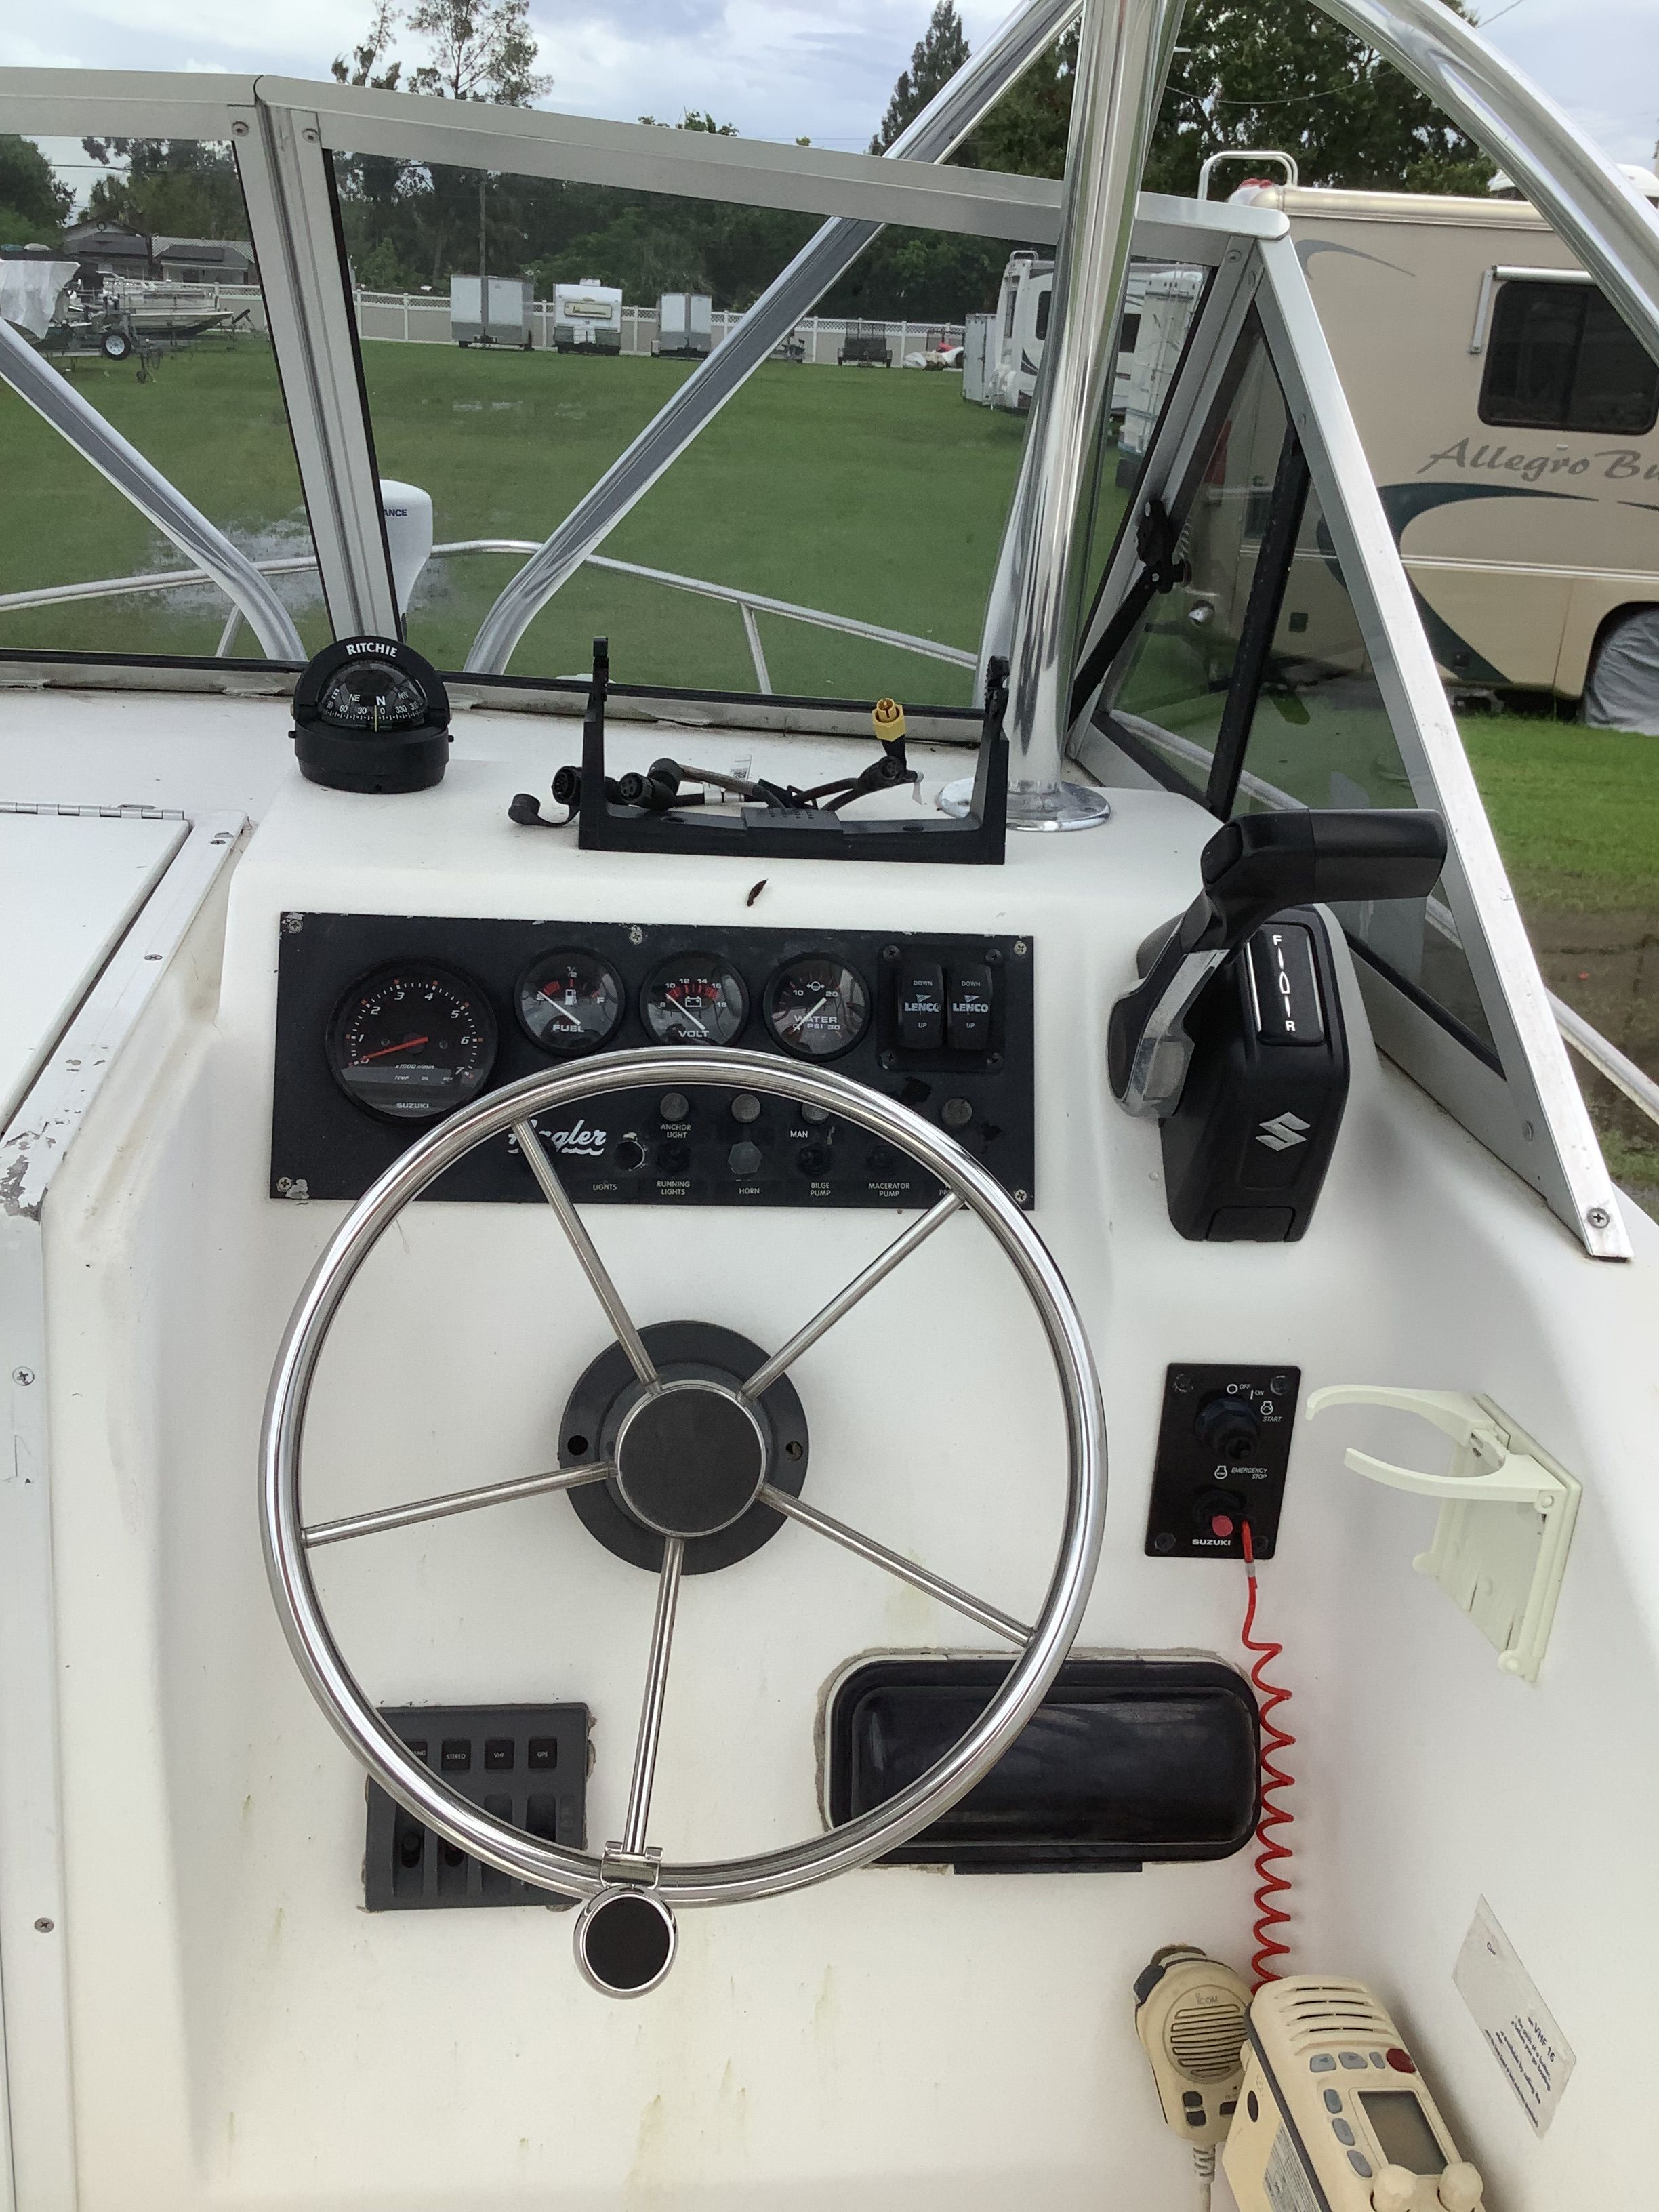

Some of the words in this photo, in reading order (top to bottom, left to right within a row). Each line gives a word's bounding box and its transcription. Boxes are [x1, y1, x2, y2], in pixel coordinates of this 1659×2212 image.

[1416, 438, 1590, 482] Allegro
[346, 642, 398, 657] RITCHIE
[331, 688, 340, 699] E
[349, 694, 361, 702] NE
[376, 696, 386, 705] N
[395, 705, 407, 713] 330
[1273, 935, 1282, 945] F
[394, 991, 405, 1000] 3
[424, 992, 434, 1001] 4
[596, 996, 605, 1004] F
[370, 1006, 380, 1015] 2
[450, 1010, 460, 1019] 5
[952, 1003, 989, 1013] LENCO
[794, 1015, 838, 1023] WATER
[552, 1024, 585, 1033] FUEL
[1286, 1020, 1295, 1031] R
[358, 1034, 365, 1042] 1
[460, 1036, 470, 1045] 6
[455, 1066, 465, 1076] 7
[660, 1124, 692, 1132] ANCHOR
[790, 1130, 808, 1139] MAN
[592, 1183, 617, 1191] LIGHTS
[811, 1182, 830, 1190] BILGE
[661, 1188, 686, 1196] LIGHTS
[1534, 2022, 1548, 2046] VHF
[1547, 2046, 1555, 2063] 16
